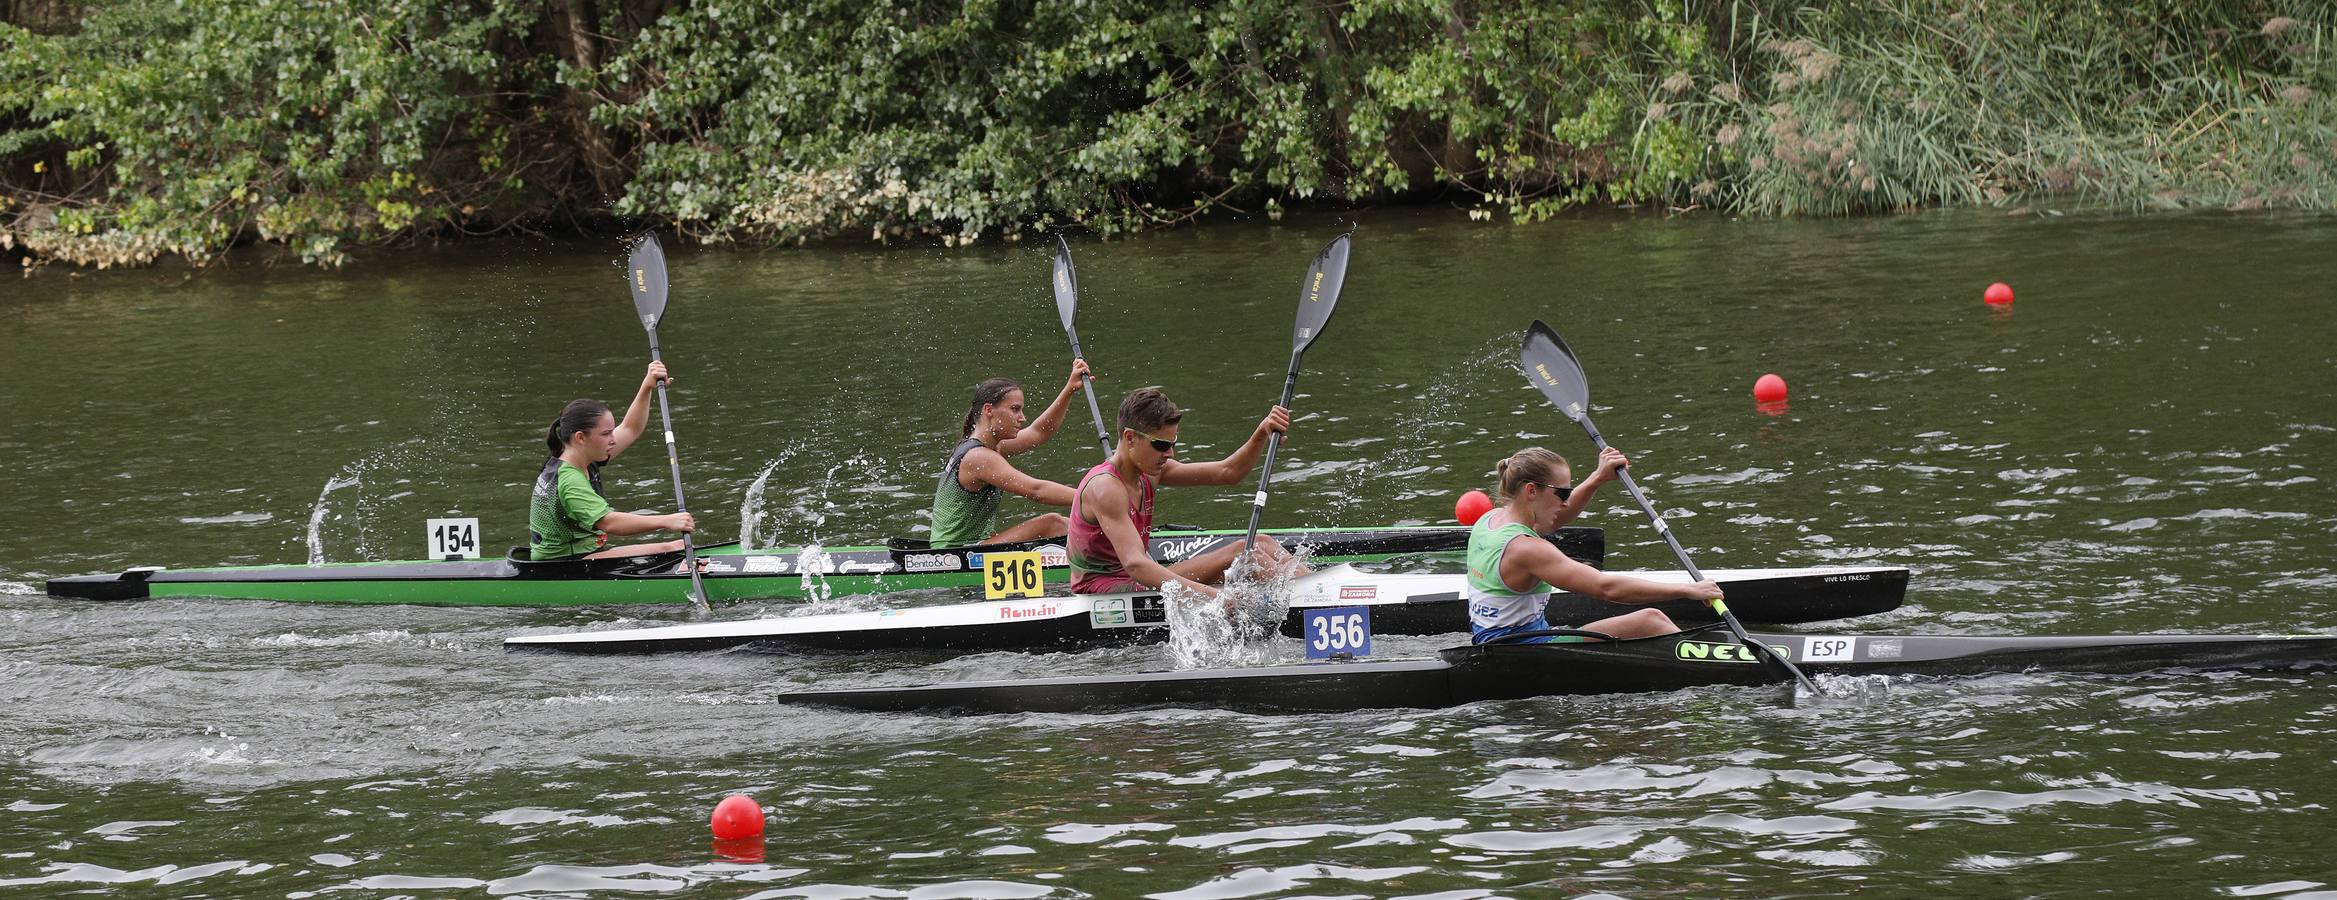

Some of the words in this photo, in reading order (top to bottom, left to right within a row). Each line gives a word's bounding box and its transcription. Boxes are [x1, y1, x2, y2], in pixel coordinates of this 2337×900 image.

[1310, 292, 1319, 302] IV
[435, 524, 475, 553] 154
[1158, 536, 1213, 560] Polledo
[991, 558, 1037, 592] 516
[1848, 574, 1871, 582] FRESCO
[1472, 603, 1499, 618] UEZ
[1312, 613, 1365, 651] 356
[1811, 640, 1847, 657] ESP
